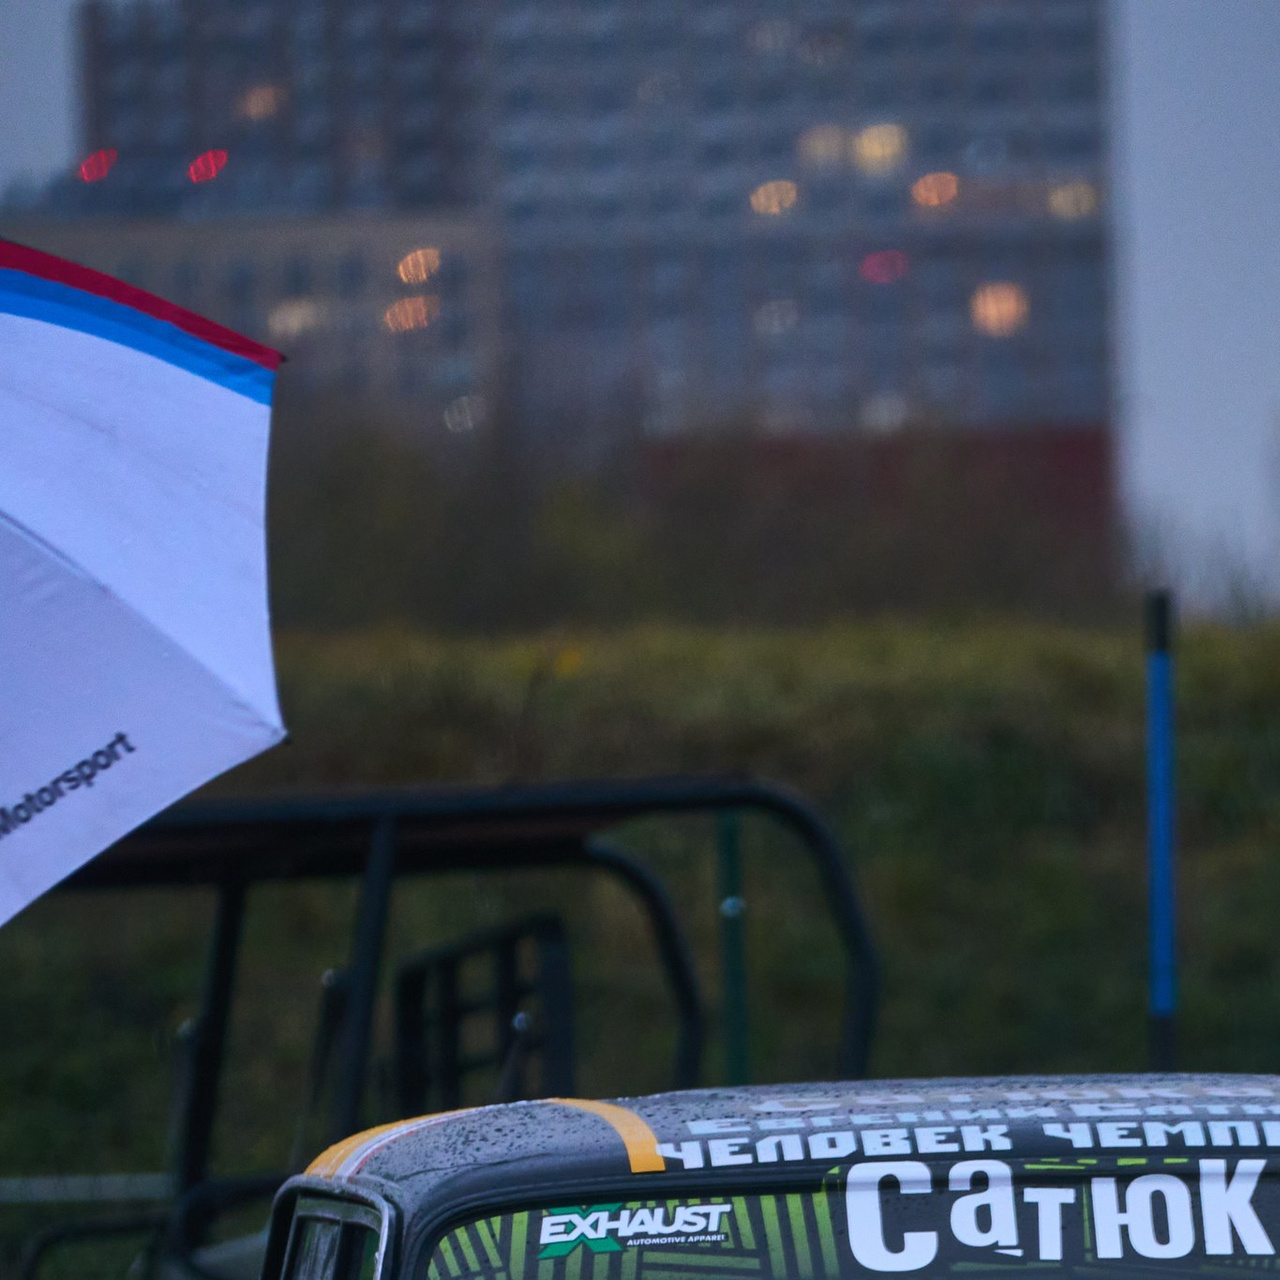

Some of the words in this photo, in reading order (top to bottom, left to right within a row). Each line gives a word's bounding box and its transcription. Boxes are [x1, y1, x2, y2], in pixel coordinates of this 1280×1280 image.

[659, 1125, 1013, 1169] ЧЕЛОВЕК
[540, 1204, 732, 1244] EXHAUST
[626, 1237, 687, 1245] AUTOMOTIVE
